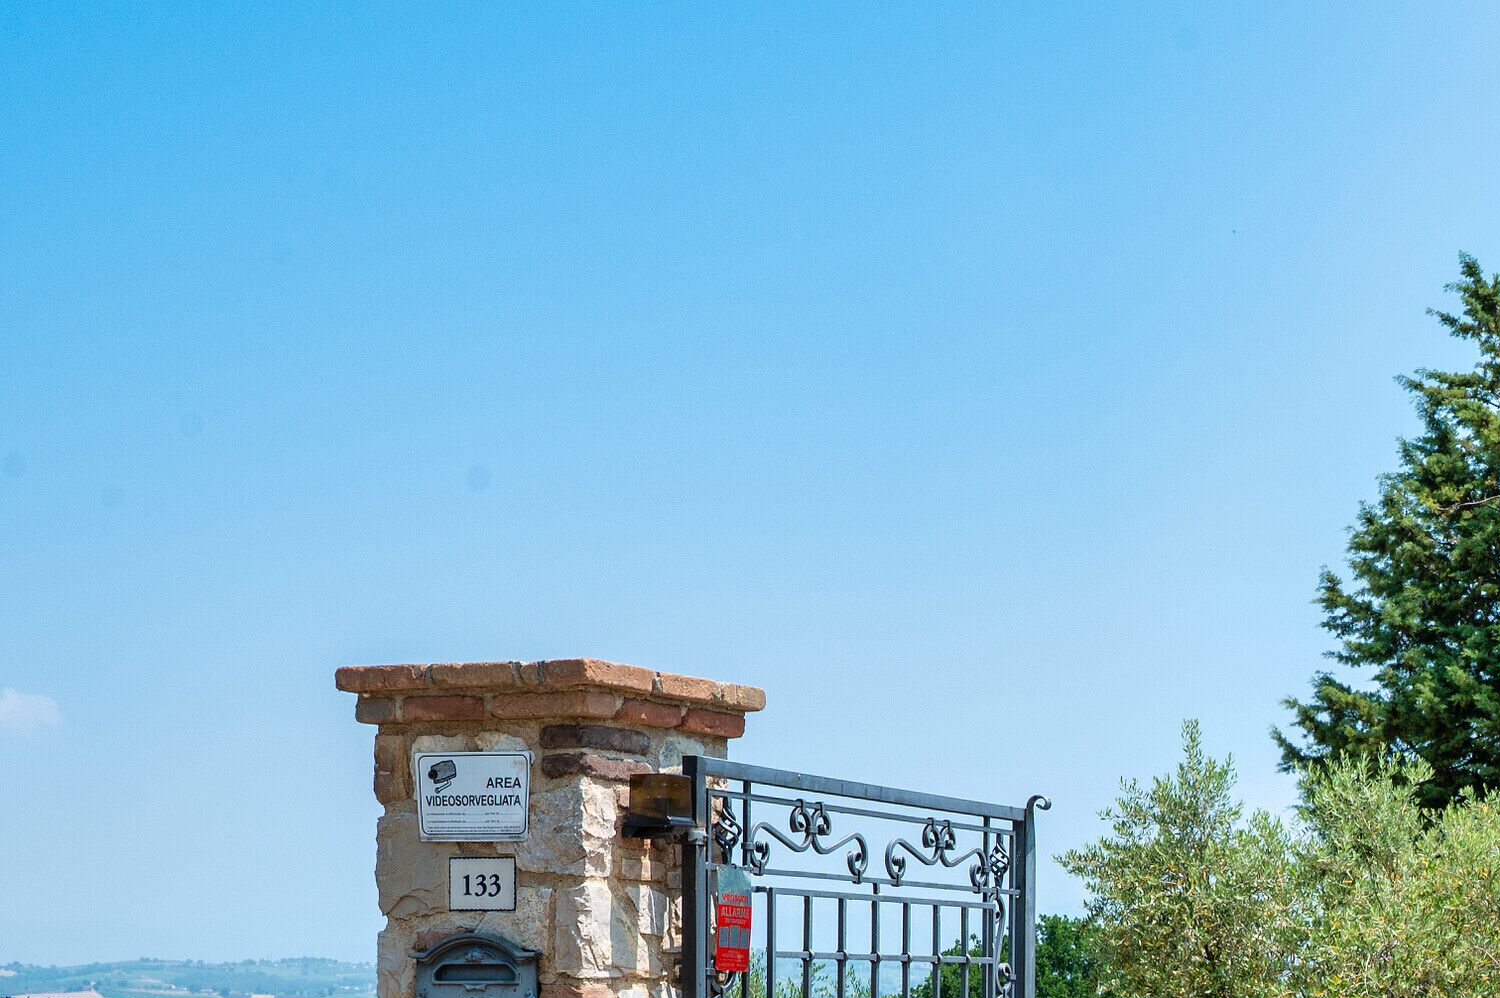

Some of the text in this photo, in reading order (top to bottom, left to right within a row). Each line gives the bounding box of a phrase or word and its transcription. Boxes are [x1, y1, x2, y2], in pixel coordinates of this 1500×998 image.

[486, 777, 521, 788] AREA
[426, 794, 521, 807] VIDEOSORVEGLIATA
[463, 874, 502, 897] 133
